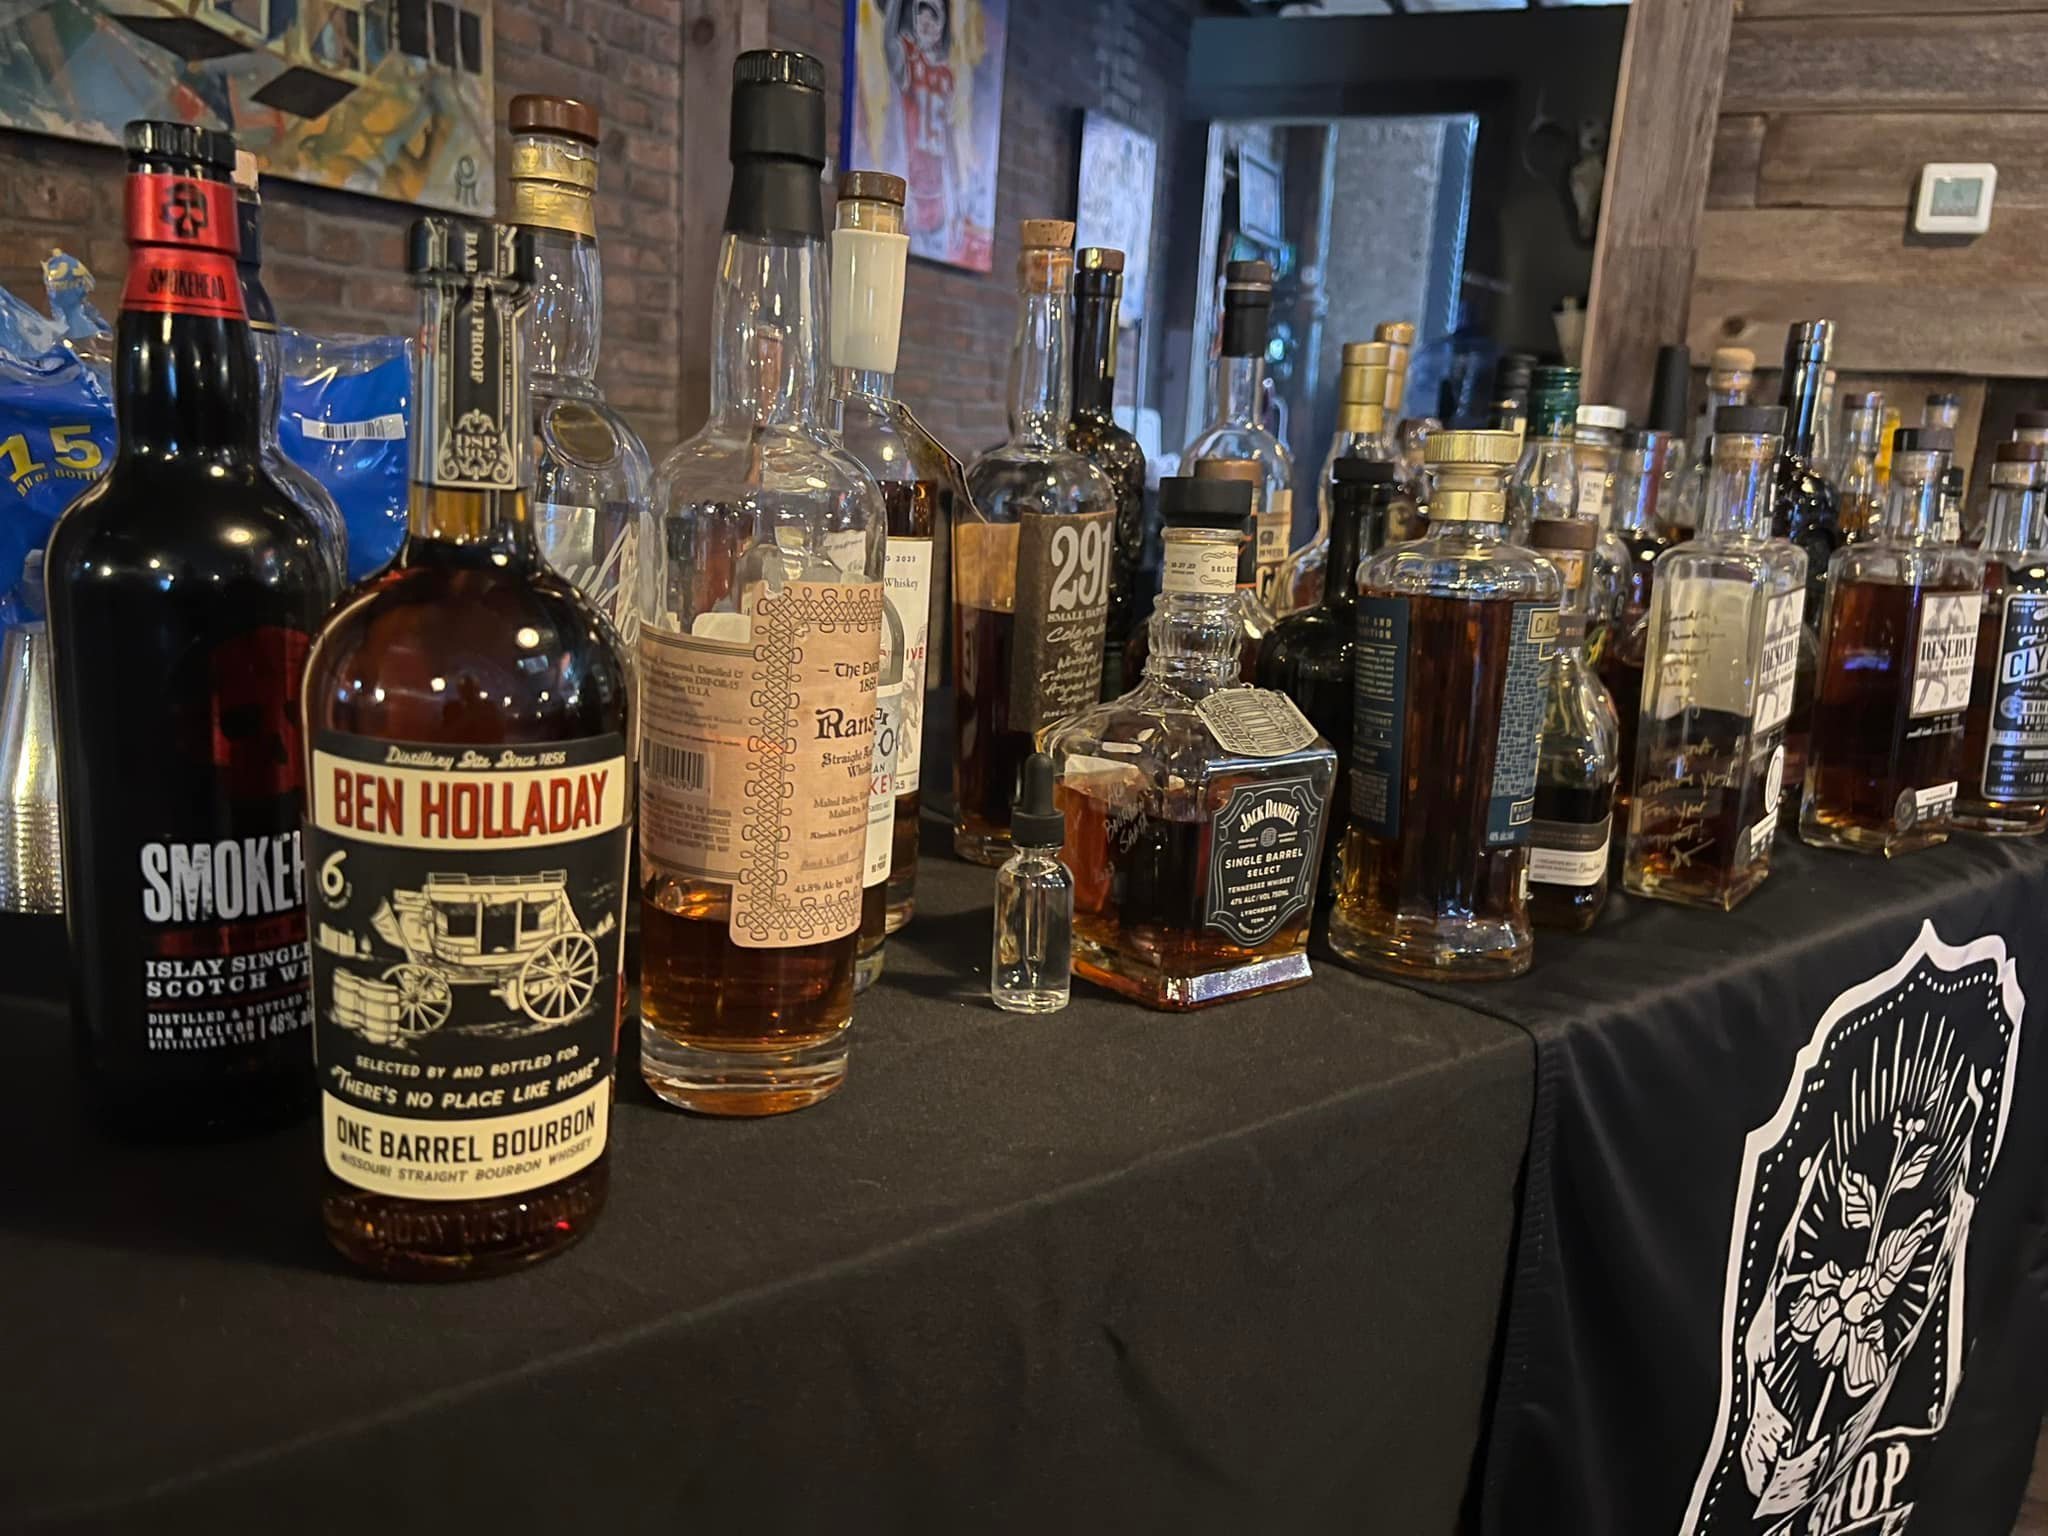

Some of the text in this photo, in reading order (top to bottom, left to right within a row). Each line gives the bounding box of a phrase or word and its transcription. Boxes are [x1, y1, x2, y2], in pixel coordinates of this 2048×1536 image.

[148, 268, 226, 300] SMOKEHEAD
[470, 318, 486, 384] PROOF
[456, 434, 498, 449] DSP
[1050, 520, 1112, 611] 291
[884, 577, 918, 592] Whiskey
[1047, 610, 1084, 623] SMALL
[385, 745, 567, 770] Distillery Site Since 1856
[334, 767, 404, 837] BEN
[420, 769, 609, 840] HOLLADAY
[1240, 805, 1265, 833] JACK
[1225, 847, 1304, 870] SINGLE BARREL
[1246, 864, 1281, 878] SELECT
[320, 850, 347, 897] 6
[1228, 875, 1296, 894] TENNESSEE WHISKEY
[1240, 904, 1278, 918] LYNCHBURG
[145, 959, 225, 978] ISLAY
[146, 971, 268, 998] SCOTCH
[148, 1010, 226, 1025] DISTILLED
[246, 993, 303, 1017] BOTTLED
[148, 1026, 174, 1040] IAN
[181, 1018, 256, 1039] MACLEOD
[269, 1010, 299, 1035] 48%
[148, 1036, 227, 1050] DISTILLERS
[356, 1045, 580, 1080] SELECTED BY AND BOTTLED FOR
[406, 1091, 434, 1109] NO
[442, 1089, 505, 1110] PLACE
[512, 1080, 551, 1103] LIKE
[336, 1101, 597, 1164] ONE BARREL BOURBON
[340, 1136, 593, 1183] MISSOURI STRAIGHT BOURBON WHISKEY
